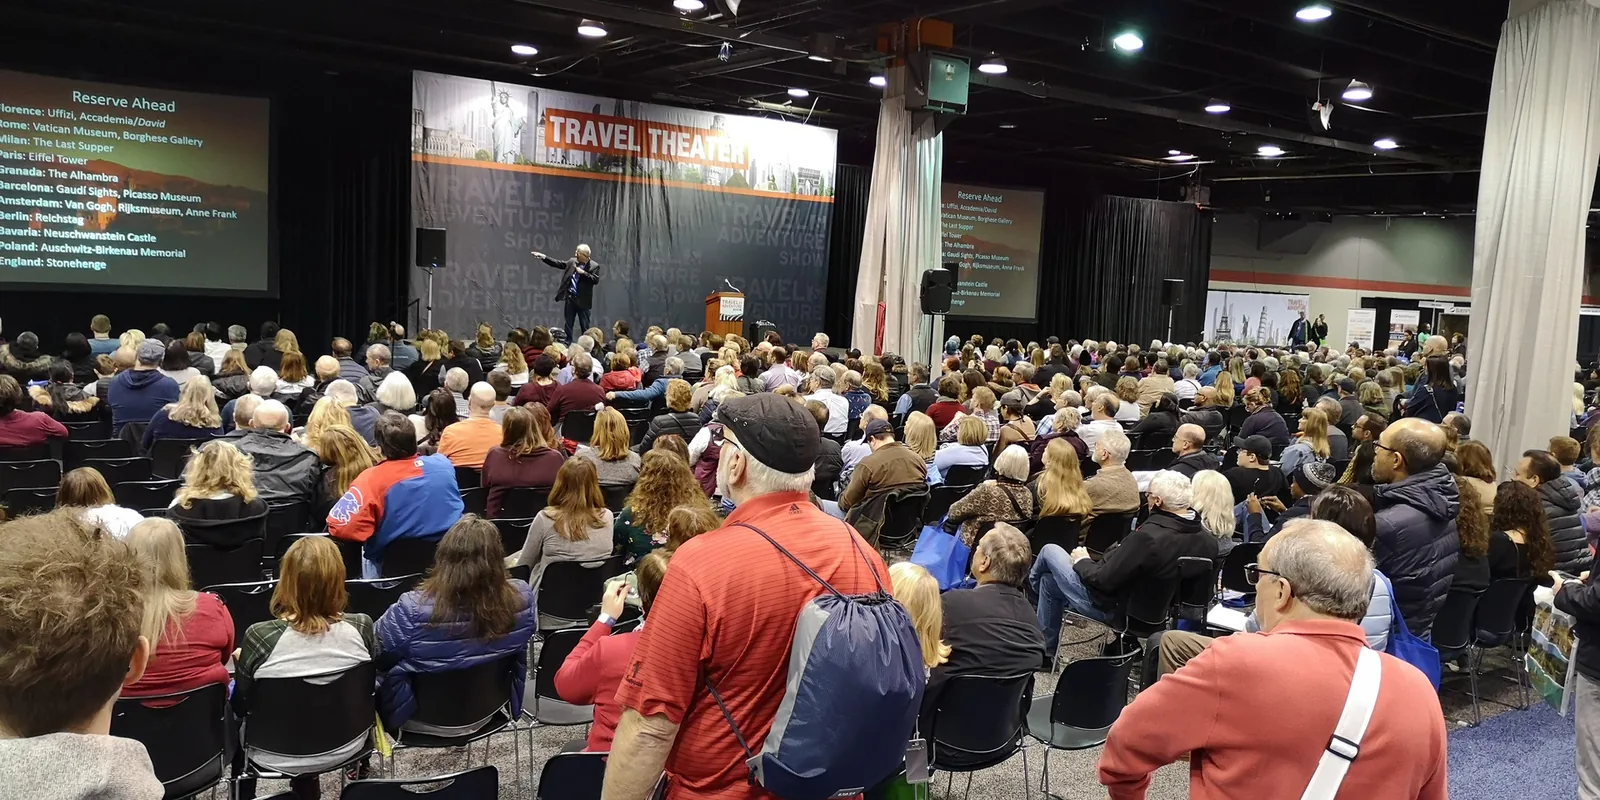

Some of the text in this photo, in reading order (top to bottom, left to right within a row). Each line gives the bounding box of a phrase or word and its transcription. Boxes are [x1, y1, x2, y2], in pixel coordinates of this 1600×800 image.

[73, 90, 176, 112] Reserve Ahead
[48, 108, 77, 121] Uffizi,
[80, 112, 166, 128] Accademia/David
[33, 122, 71, 134] Vatican
[73, 126, 121, 140] Museum,
[123, 131, 168, 144] Borghese
[170, 135, 203, 148] Gallery
[33, 137, 53, 147] The
[55, 139, 76, 149] Last
[78, 141, 114, 153] Supper
[549, 115, 745, 165] TRAVEL THEATER
[0, 150, 88, 165] Paris: Eiffel Tower
[0, 165, 119, 183] Granada: The Alhambra
[0, 181, 202, 203] Barcelona: Gaudí Sights, Picasso Museum
[958, 190, 1002, 203] Reserve Ahead
[0, 196, 238, 219] Amsterdam: Van Gogh, Rijksmuseum, Anne Frank
[440, 202, 564, 231] DVENTURE
[718, 200, 807, 230] TRAVEL
[0, 211, 85, 226] Berlin: Reichstag
[978, 216, 997, 225] Borghese
[998, 217, 1013, 225] Gallery
[0, 226, 157, 243] Bavaria: Neuschwanstein Castle
[504, 231, 563, 251] SHOW
[717, 227, 825, 251] ADVENTURE
[0, 241, 186, 258] Poland: Auschwitz-Birkenau Memorial
[953, 241, 975, 250] Alhambra
[0, 256, 107, 271] England: Stonehenge
[779, 251, 824, 267] SHOW
[440, 260, 539, 291] RAVEL
[438, 289, 561, 312] DVENTURE
